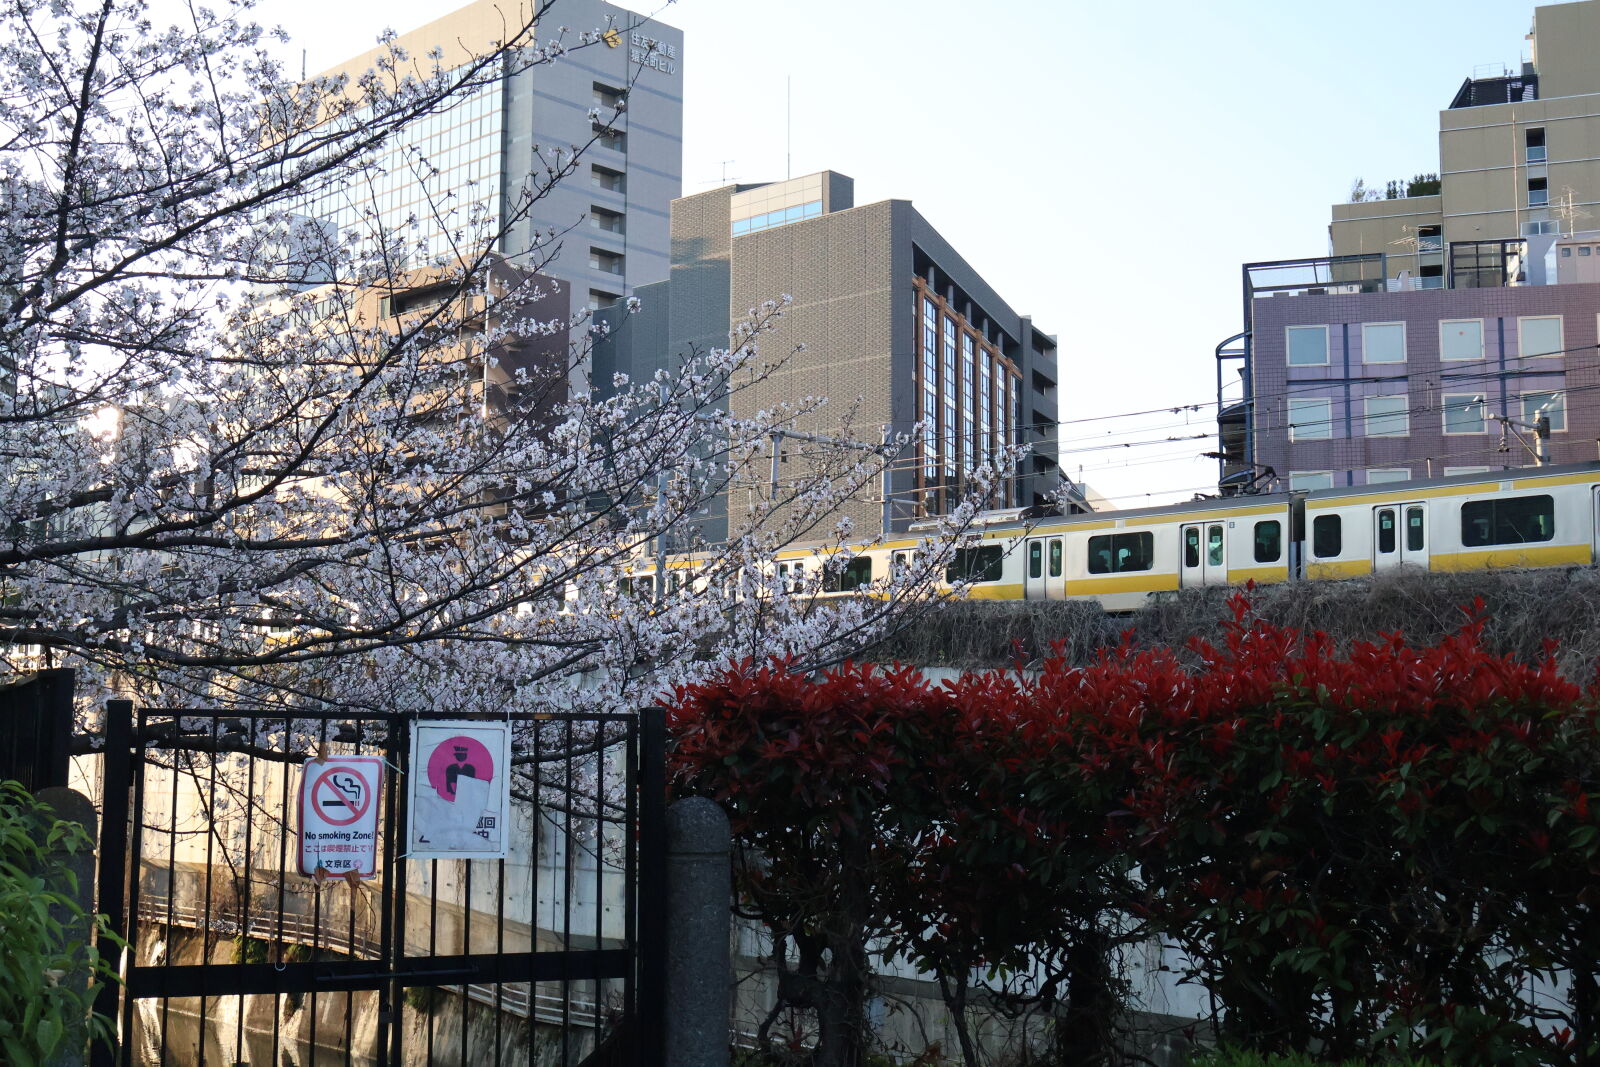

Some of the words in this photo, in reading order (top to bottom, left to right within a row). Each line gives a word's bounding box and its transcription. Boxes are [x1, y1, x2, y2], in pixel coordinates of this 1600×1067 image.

[305, 831, 316, 840] No
[318, 831, 351, 842] smoking
[352, 831, 374, 840] Zone!
[325, 859, 352, 868] 文京区
